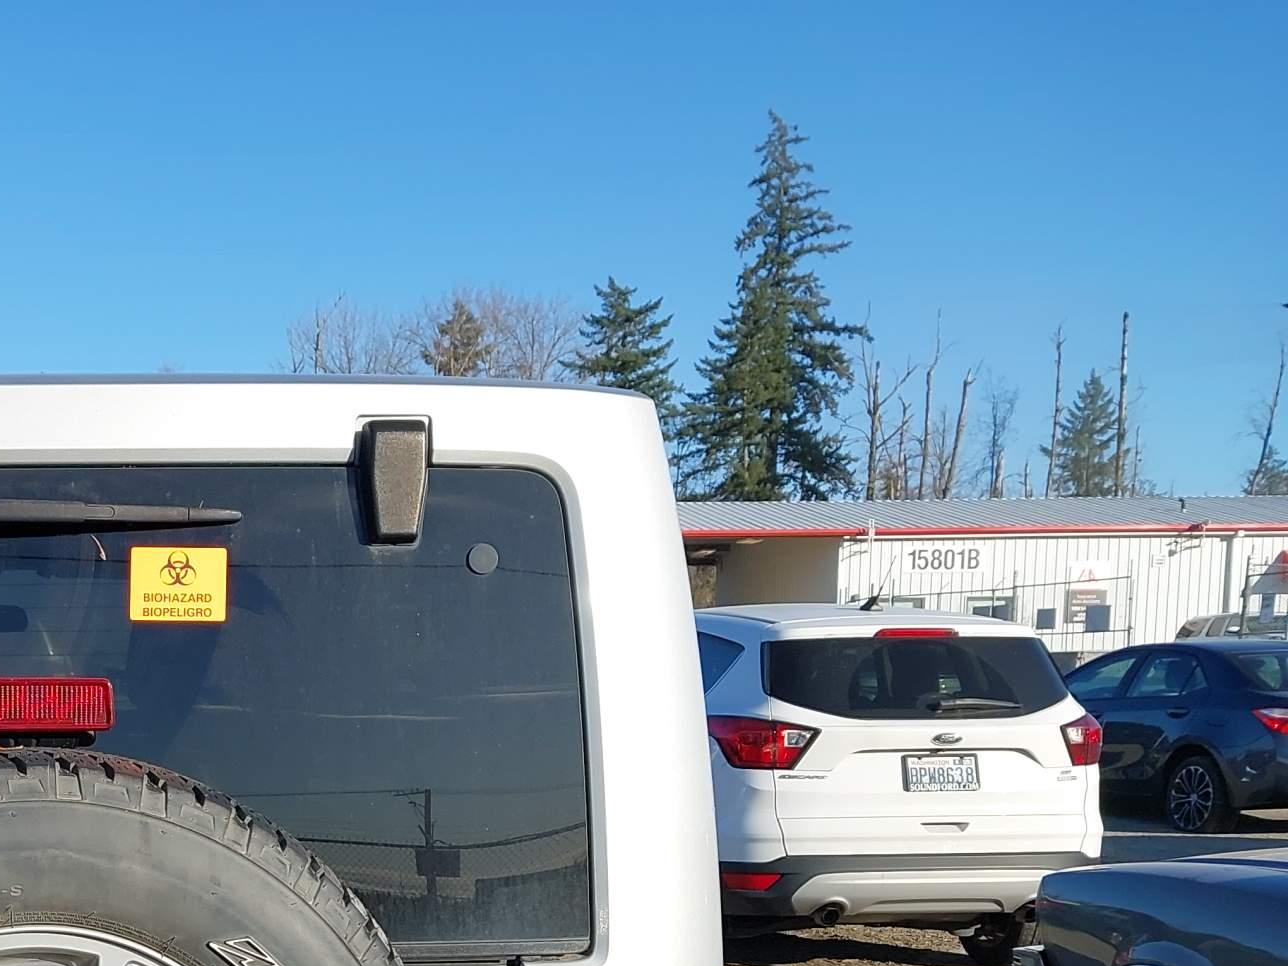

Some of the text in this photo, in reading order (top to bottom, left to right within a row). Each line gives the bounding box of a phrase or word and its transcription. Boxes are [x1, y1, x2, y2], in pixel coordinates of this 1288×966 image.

[908, 549, 980, 570] 15801B
[143, 593, 212, 603] BIOHAZARD
[142, 607, 212, 617] BIOPELIGRO
[910, 767, 974, 784] BPW8638
[910, 783, 980, 792] SOUNDFORD.COM
